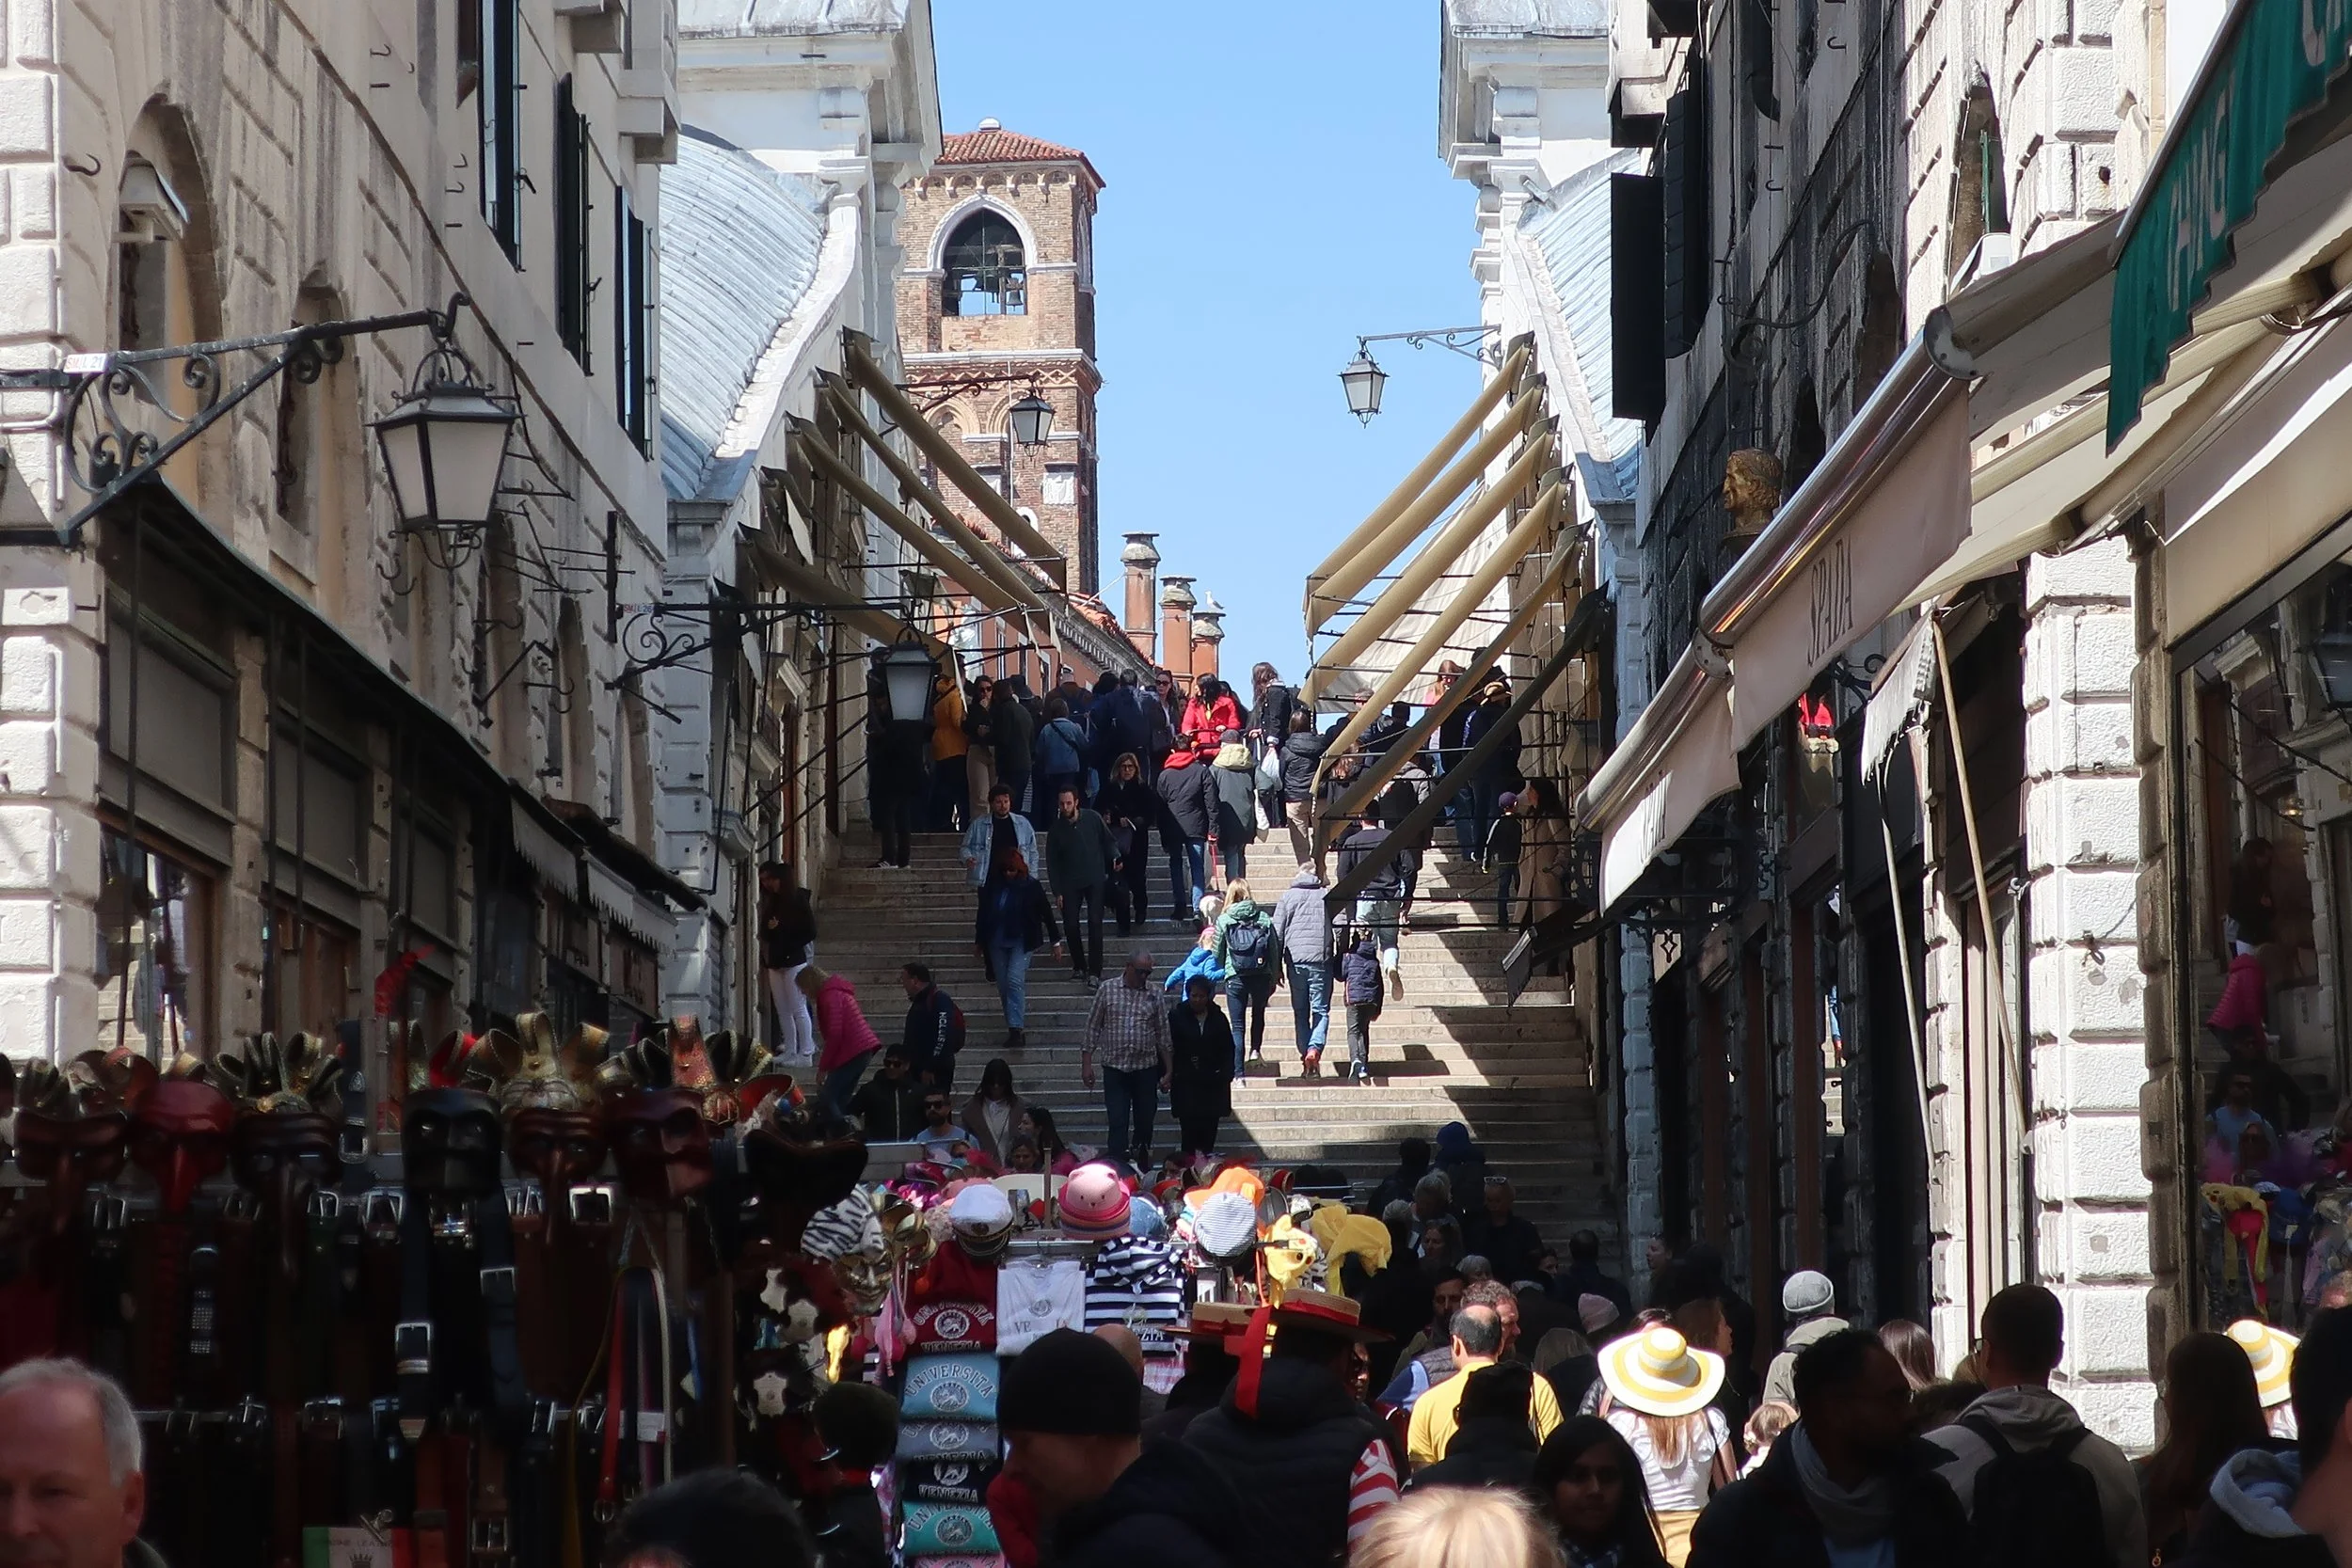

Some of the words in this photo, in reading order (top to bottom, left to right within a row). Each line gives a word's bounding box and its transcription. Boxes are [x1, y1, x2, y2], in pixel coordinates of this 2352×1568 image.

[1807, 535, 1853, 668] SPADA
[904, 1363, 996, 1400] UNIVERSITA
[918, 1483, 978, 1503] VENEZIA
